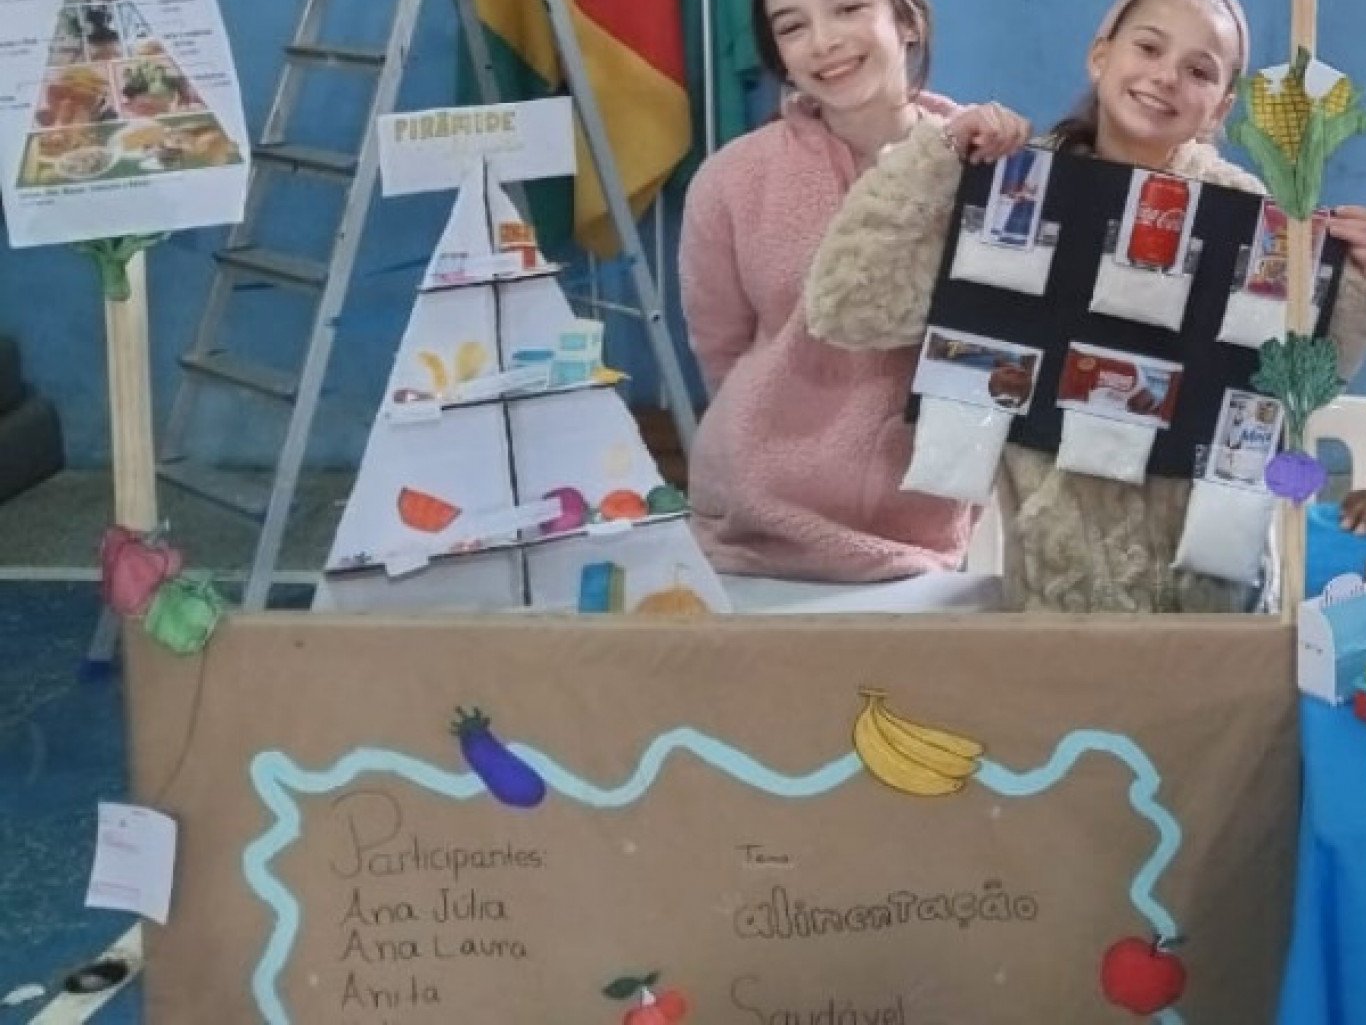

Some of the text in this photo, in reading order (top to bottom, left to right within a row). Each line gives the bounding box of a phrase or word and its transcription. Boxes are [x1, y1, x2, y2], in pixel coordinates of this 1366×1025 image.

[340, 887, 418, 926] Ana
[339, 928, 527, 964] Ana Laura
[341, 969, 441, 1010] Anita
